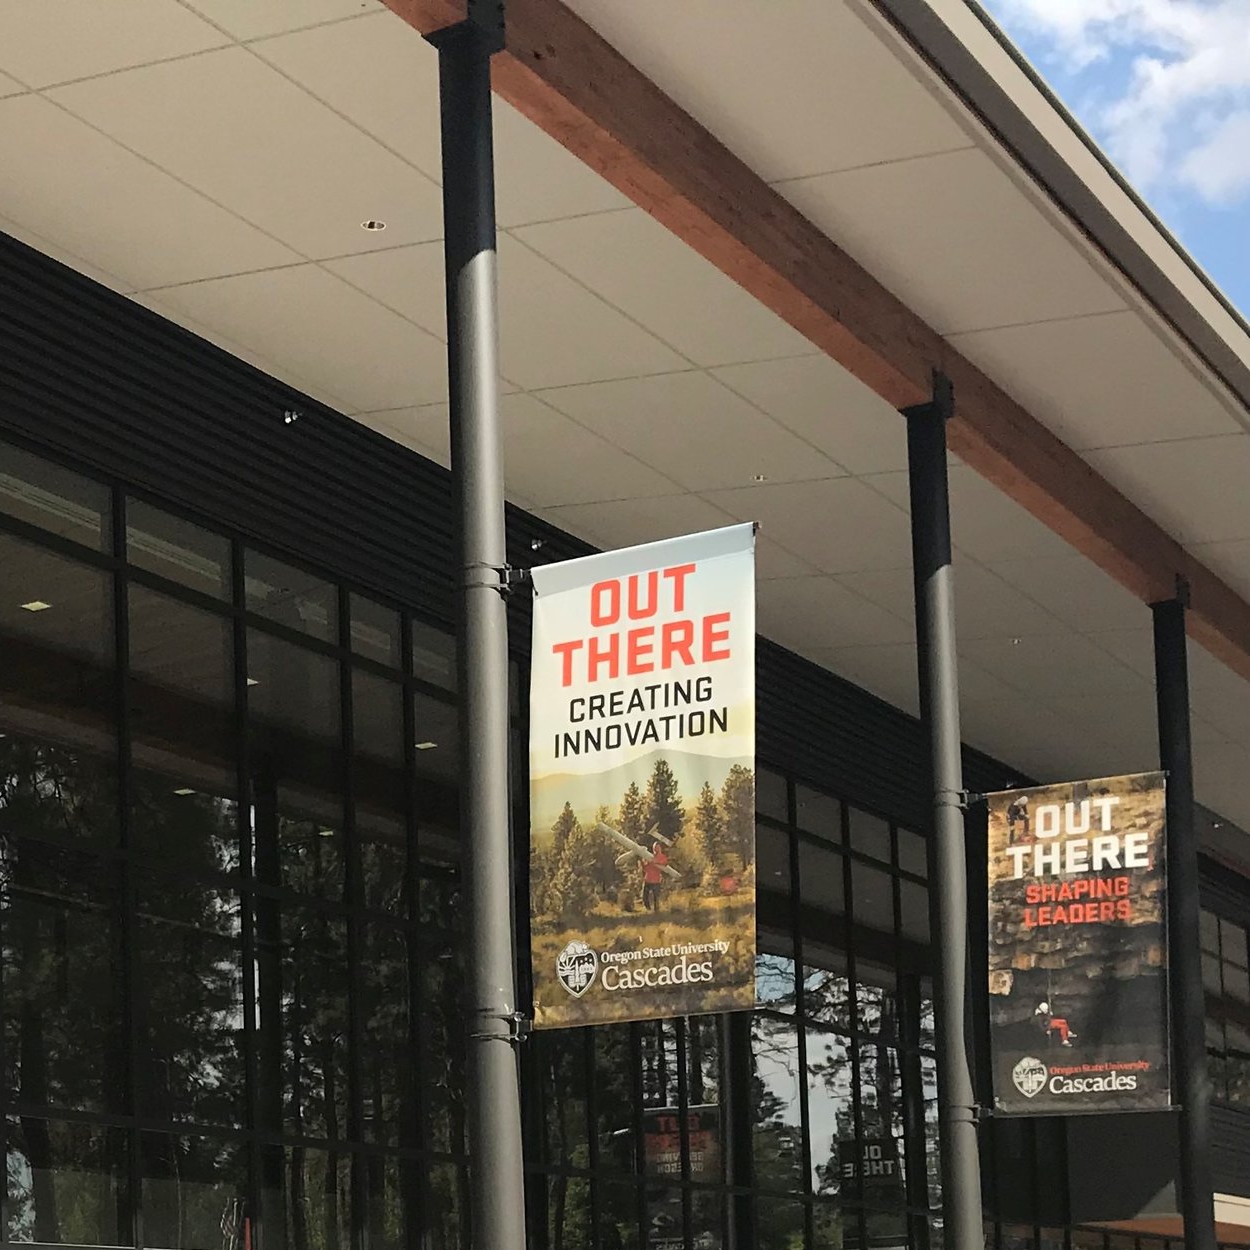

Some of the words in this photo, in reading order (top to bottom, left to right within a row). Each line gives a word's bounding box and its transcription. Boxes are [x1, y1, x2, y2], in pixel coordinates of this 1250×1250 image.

[590, 563, 696, 628] OUT
[552, 612, 731, 687] THERE
[569, 676, 713, 723] CREATING
[554, 707, 728, 758] INNOVATION
[1035, 797, 1120, 839] OUT
[1006, 832, 1150, 879] THERE
[1026, 877, 1129, 904] SHAPING
[1024, 900, 1132, 928] LEADERS
[600, 950, 642, 965] Oregon
[642, 945, 672, 959] State
[671, 939, 730, 956] University
[601, 955, 714, 991] Cascades
[1049, 1071, 1137, 1094] Cascades
[1050, 1066, 1082, 1075] Oregon
[1105, 1061, 1150, 1072] University
